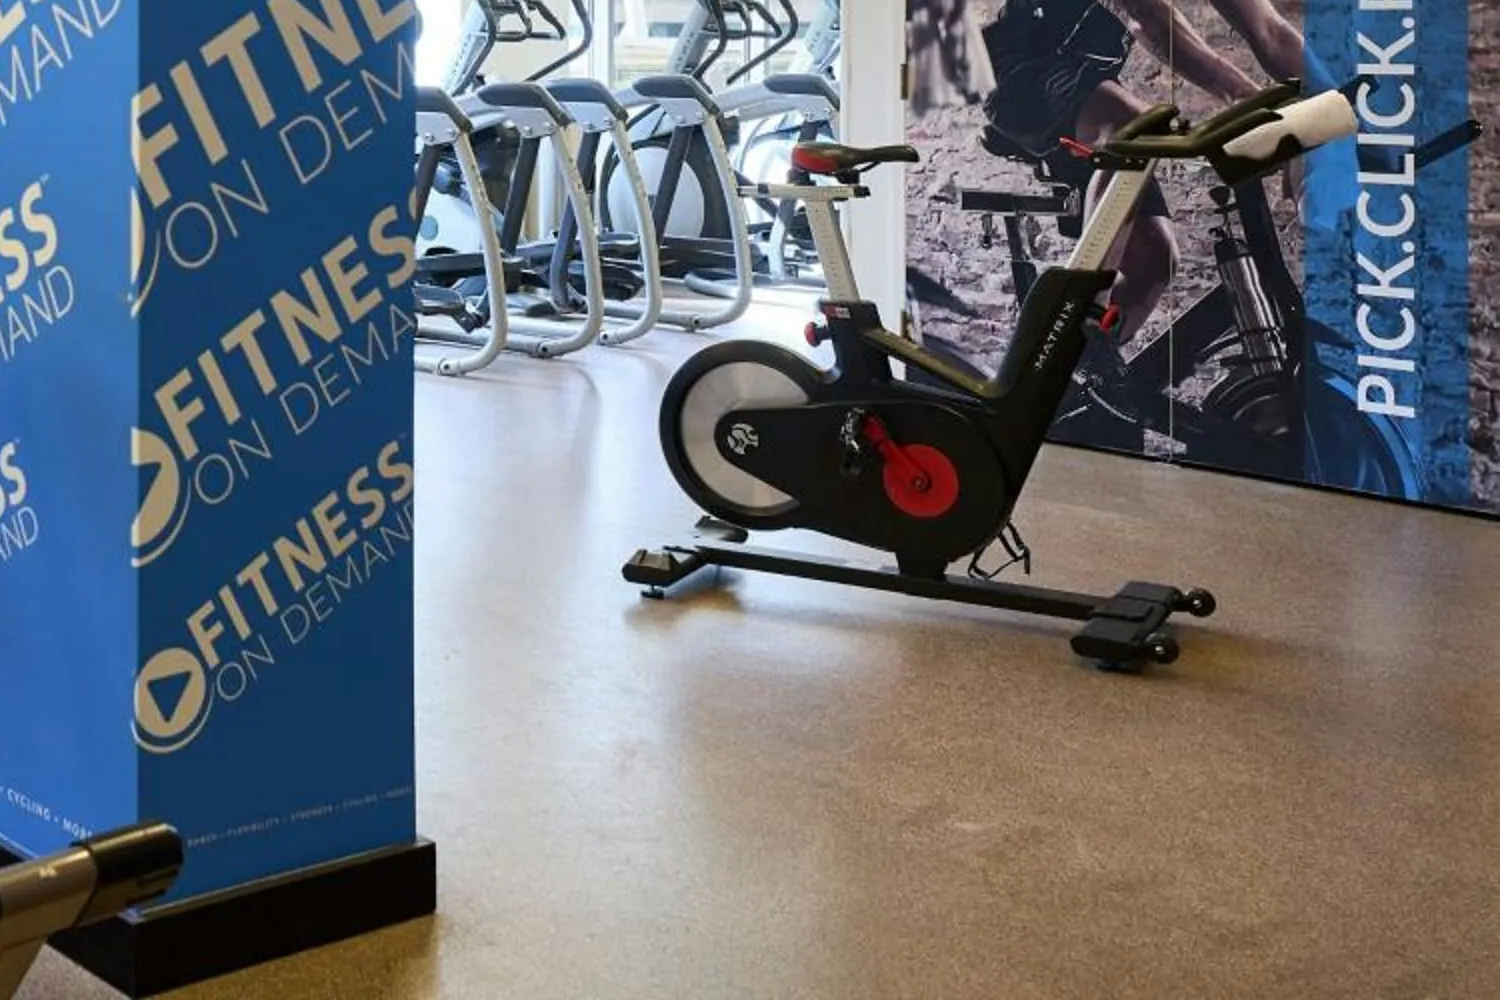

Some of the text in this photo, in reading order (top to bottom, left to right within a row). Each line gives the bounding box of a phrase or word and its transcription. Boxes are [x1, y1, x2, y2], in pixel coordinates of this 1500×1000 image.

[166, 159, 268, 268] ON
[155, 187, 416, 460] FITNES
[1034, 300, 1076, 372] MATRIX
[195, 419, 272, 504] ON
[186, 441, 414, 669] FITNESS
[216, 634, 274, 701] ON
[7, 787, 51, 822] CYCLING
